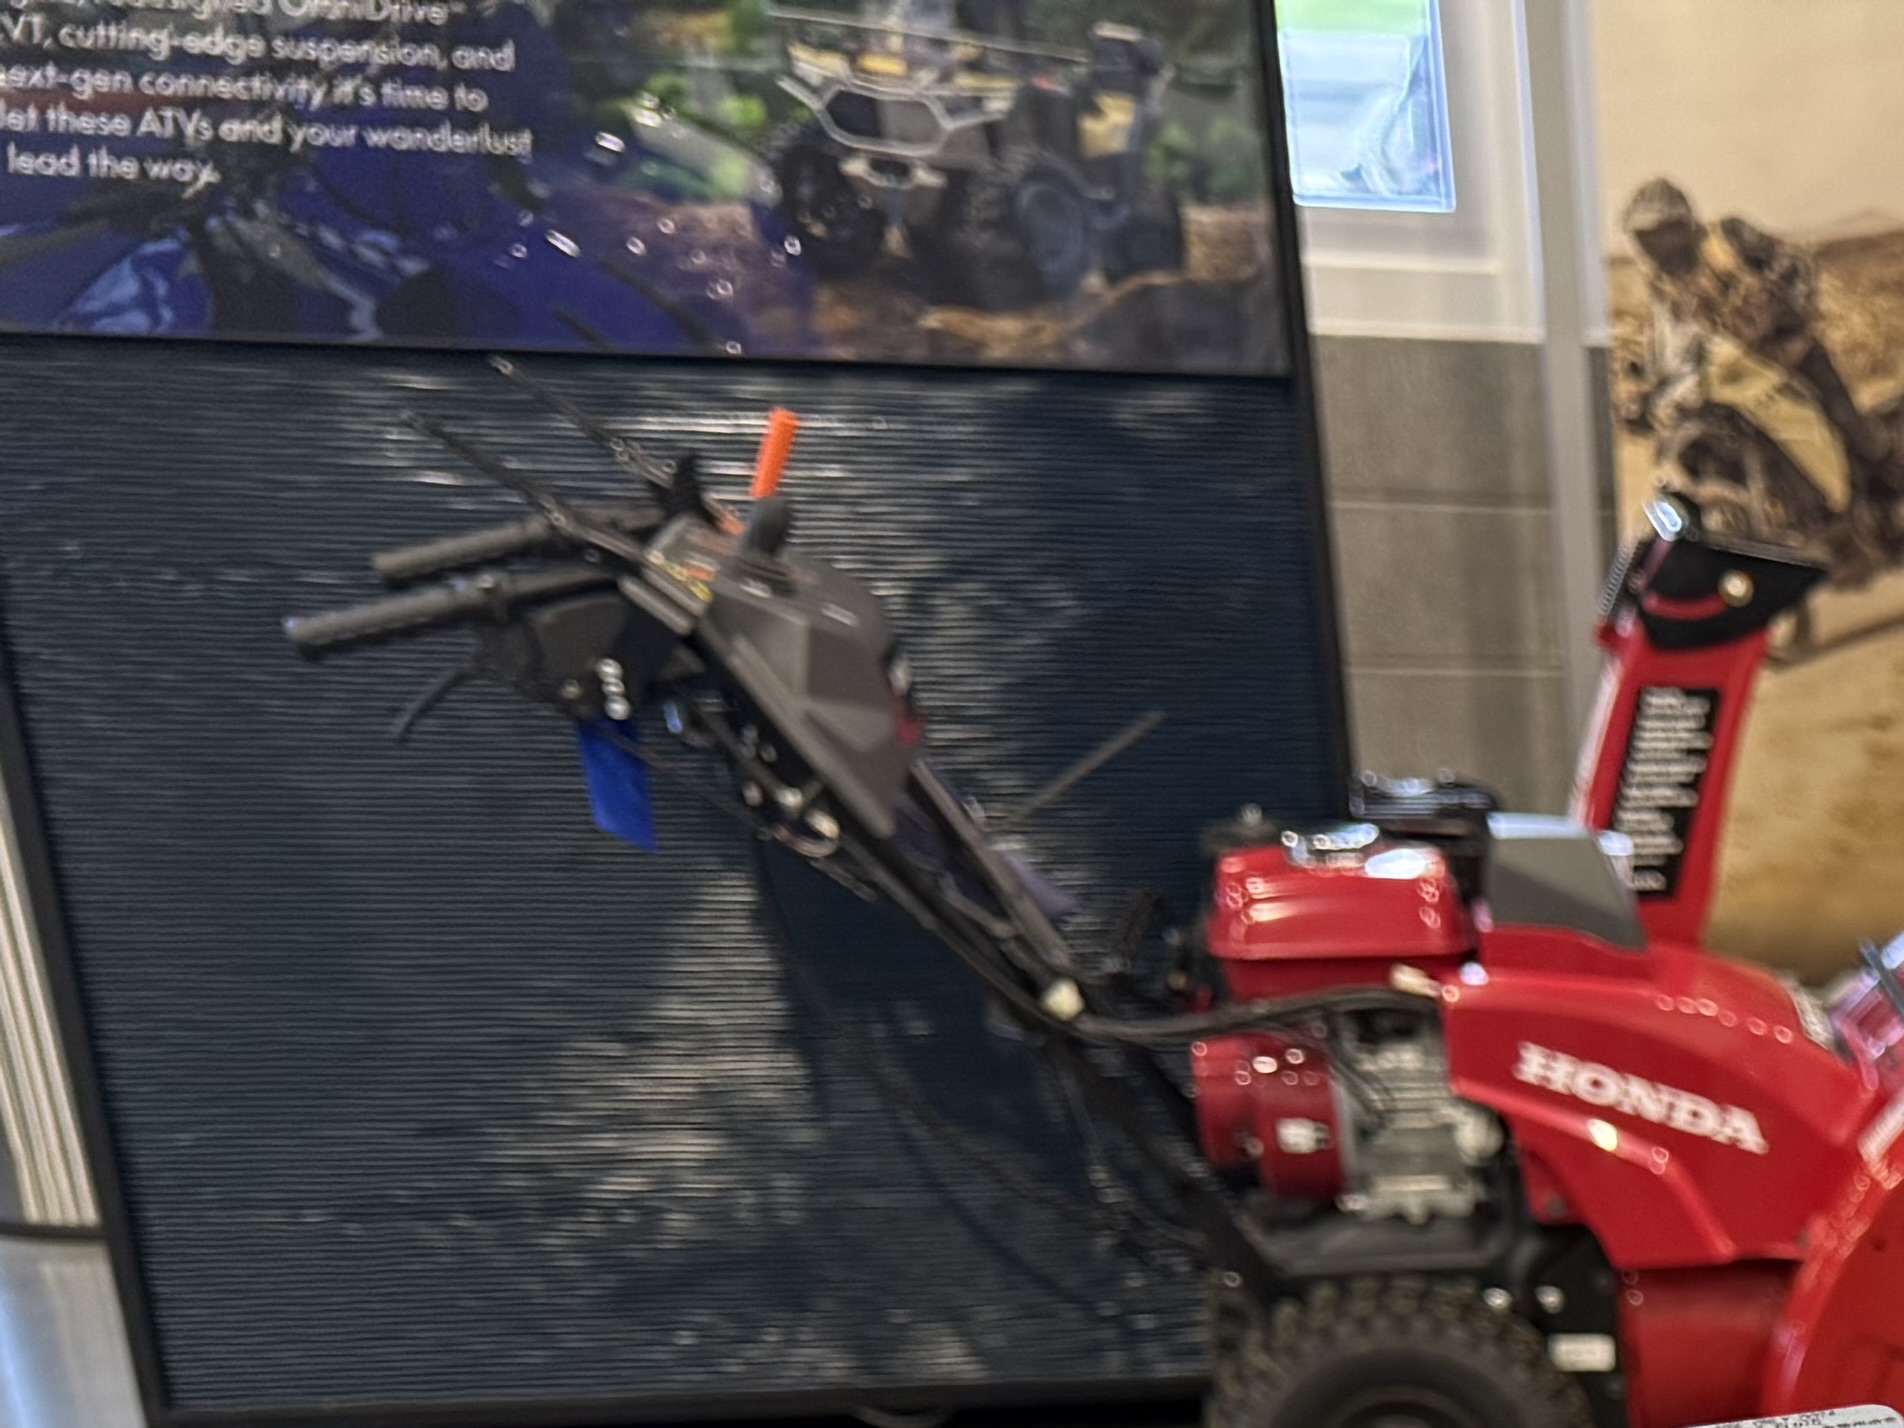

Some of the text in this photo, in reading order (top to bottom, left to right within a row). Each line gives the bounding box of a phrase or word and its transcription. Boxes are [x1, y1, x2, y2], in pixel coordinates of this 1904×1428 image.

[0, 13, 515, 73] VT, cutting-edge suspension, and
[380, 78, 450, 110] time
[454, 82, 490, 113] to
[46, 101, 132, 137] these
[136, 105, 214, 142] ATVs
[218, 111, 283, 145] and
[286, 121, 357, 153] your
[362, 119, 533, 157] wanderlust
[7, 141, 222, 199] lead the way.
[1511, 1040, 1770, 1155] HONDA
